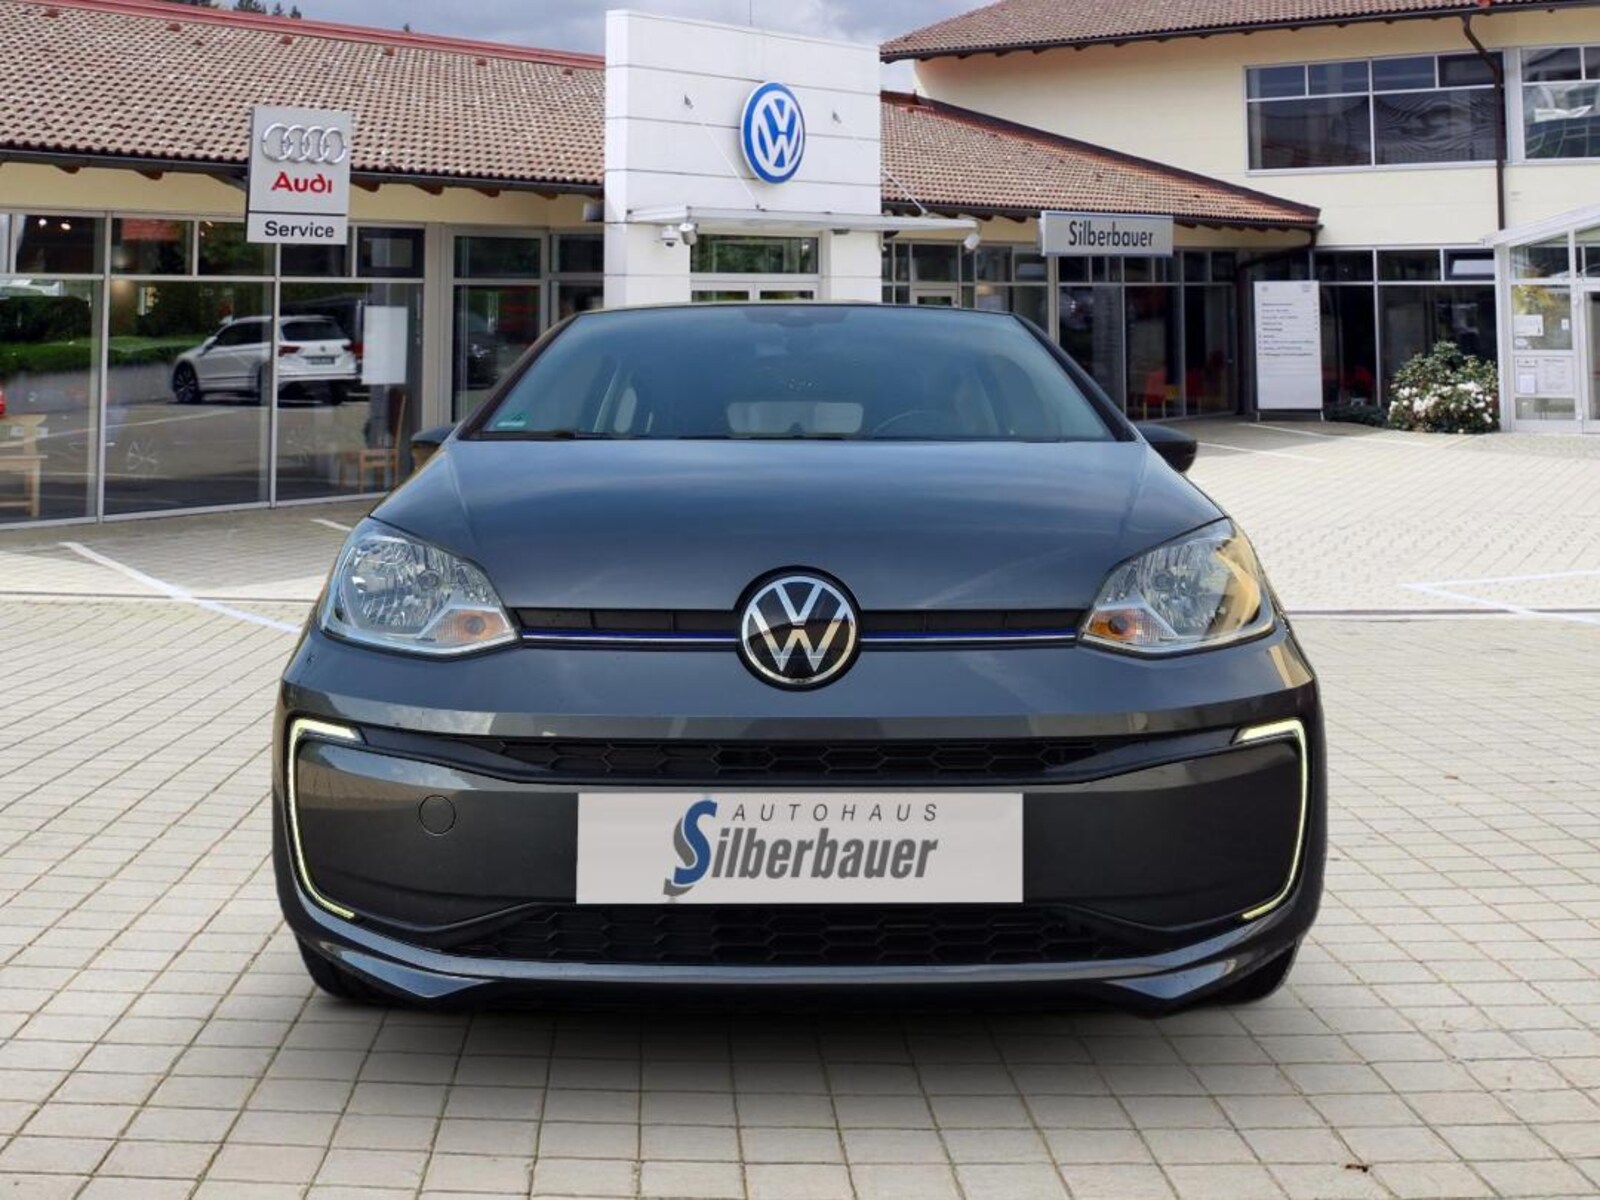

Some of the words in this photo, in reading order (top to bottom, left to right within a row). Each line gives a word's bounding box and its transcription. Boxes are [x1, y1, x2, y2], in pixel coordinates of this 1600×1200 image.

[271, 171, 333, 194] Audi
[264, 220, 335, 238] Service
[1068, 219, 1154, 247] Silberbauer
[732, 803, 938, 822] AUTOHAUS
[664, 799, 938, 896] Silberbauer
